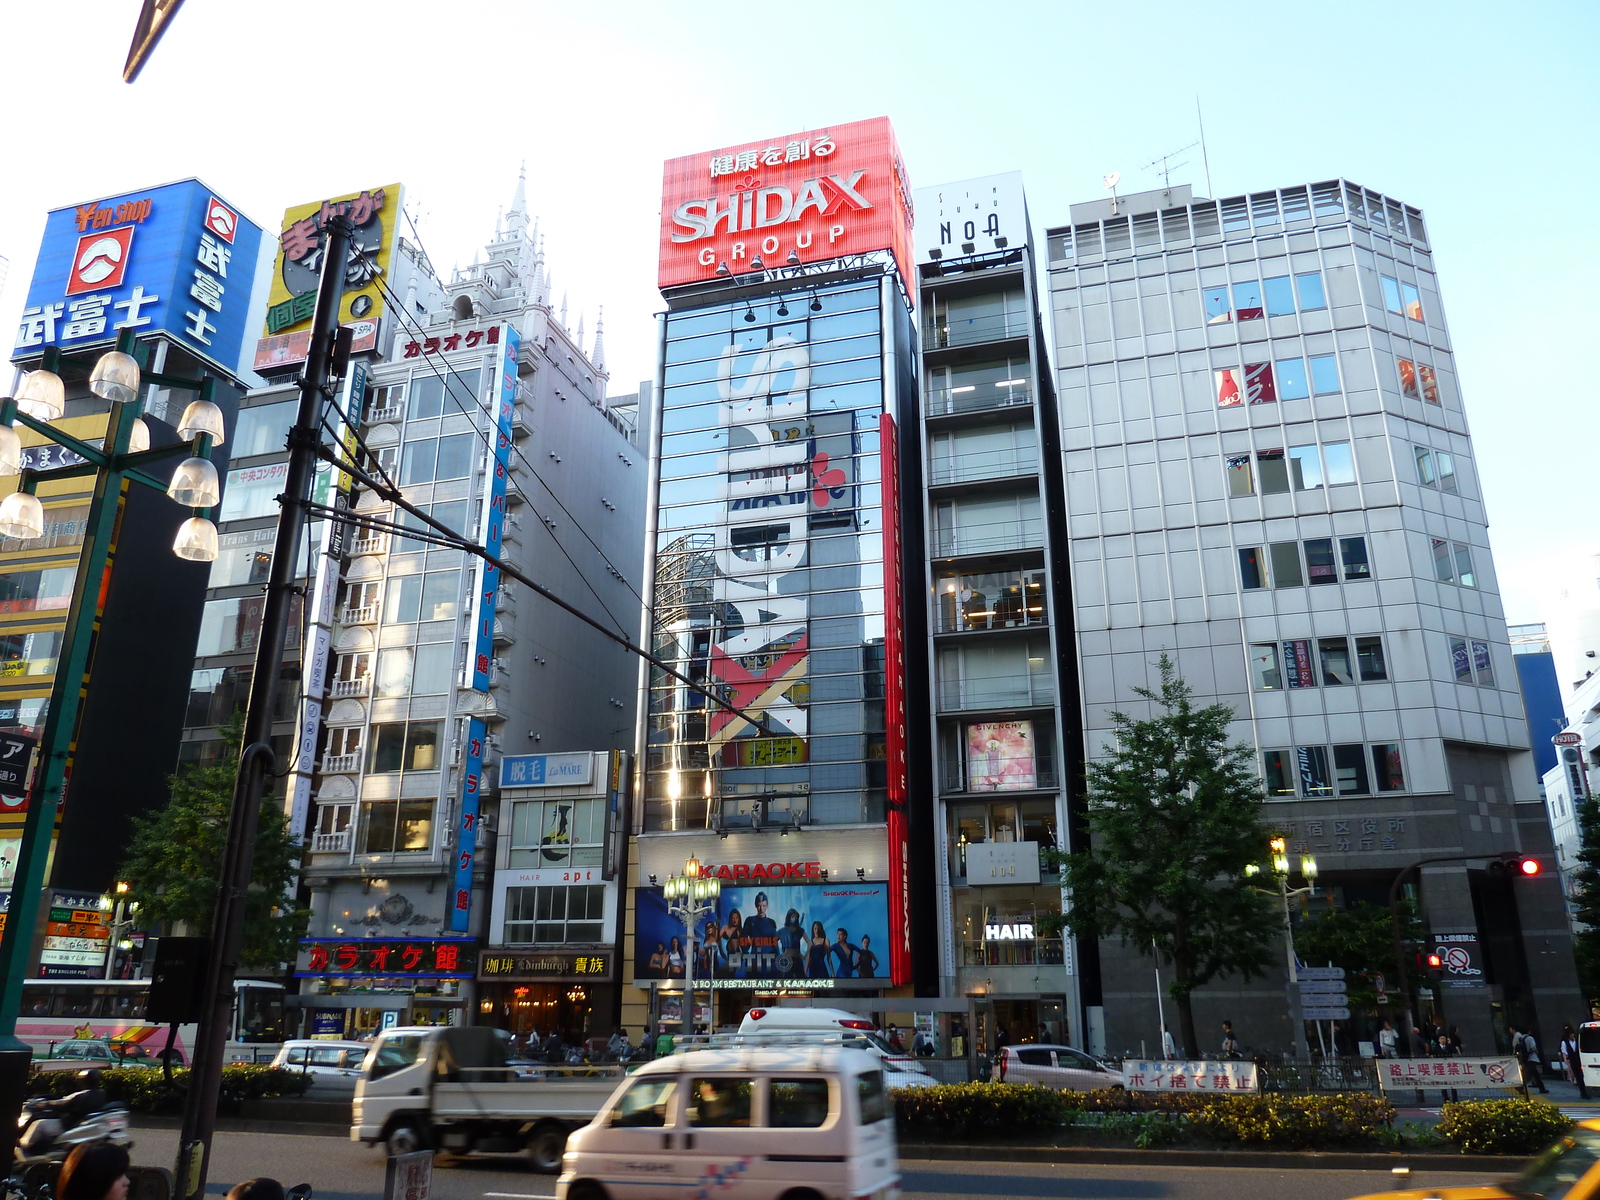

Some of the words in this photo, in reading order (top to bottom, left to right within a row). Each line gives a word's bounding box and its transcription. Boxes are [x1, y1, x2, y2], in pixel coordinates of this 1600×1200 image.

[709, 134, 837, 178] 健康を創る
[114, 198, 153, 225] shop
[671, 167, 874, 243] SHIDAX
[940, 213, 999, 245] NOA
[698, 224, 845, 266] GROUP
[186, 233, 233, 347] 武富士
[19, 286, 159, 348] 武富士
[404, 326, 500, 358] カラオケ館
[253, 531, 276, 542] Hair
[897, 628, 906, 791] KARAOKE
[1556, 732, 1579, 744] HOTEL
[510, 760, 541, 781] 脱毛
[560, 765, 582, 776] MARE
[455, 738, 482, 911] カラオケ館
[1278, 817, 1407, 837] 新宿区役所
[697, 861, 821, 881] KARAOKE
[902, 840, 911, 952] SHIDAX
[755, 937, 778, 946] GIRLS
[985, 923, 1035, 940] HAIR
[308, 944, 459, 970] カラオケ館
[484, 957, 515, 974] 珈琲
[575, 957, 604, 974] 貴族
[724, 979, 774, 988] RESTAURANT
[784, 979, 835, 988] KARAOKE
[385, 1013, 395, 1027] P
[1389, 1062, 1475, 1077] 路上喫煙禁止
[1128, 1073, 1253, 1090] ポイ捨て禁止
